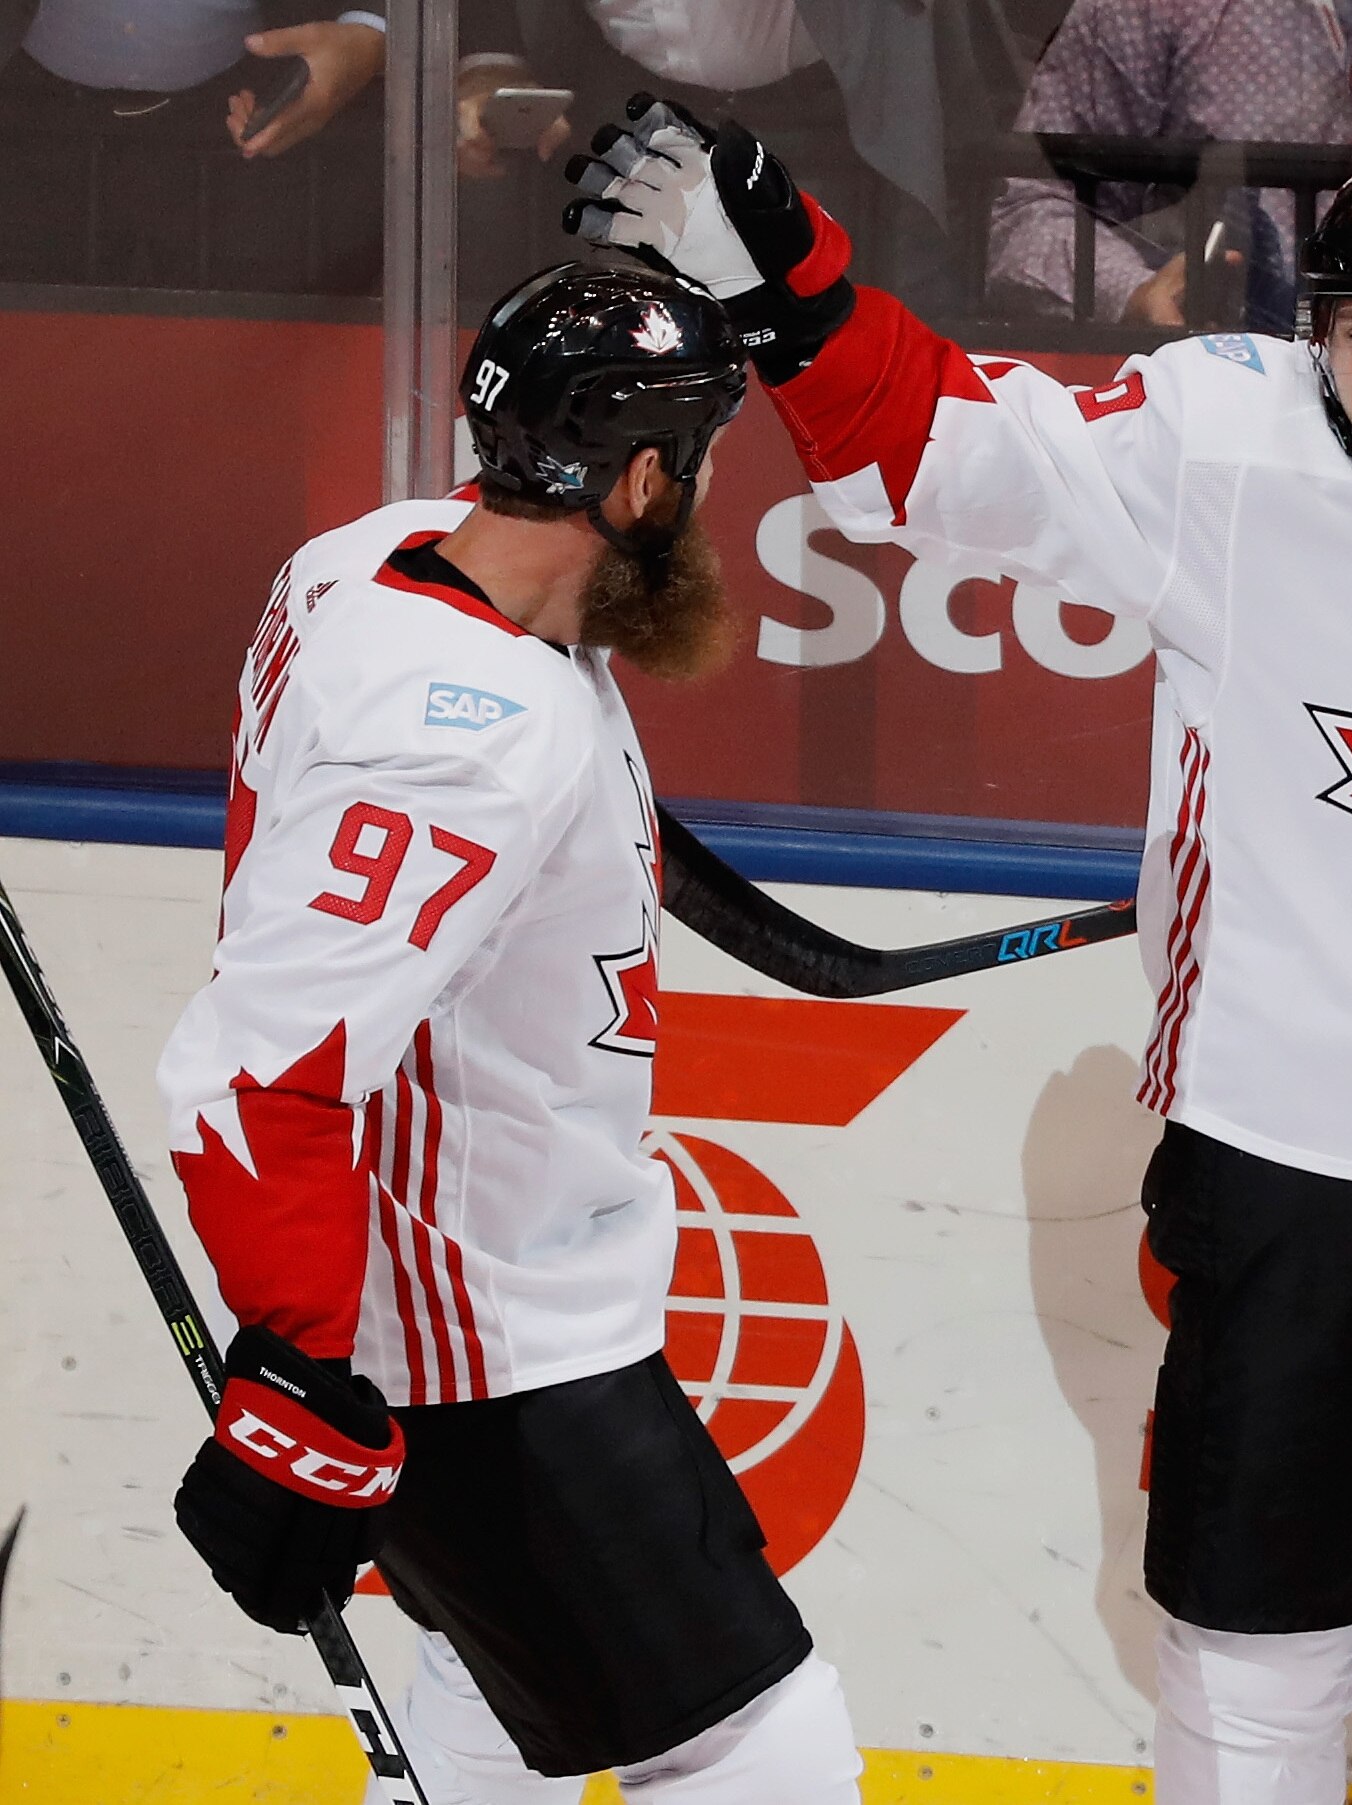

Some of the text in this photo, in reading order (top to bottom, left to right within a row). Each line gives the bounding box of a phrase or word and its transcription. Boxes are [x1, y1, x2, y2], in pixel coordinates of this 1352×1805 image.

[470, 359, 510, 412] 97
[428, 690, 503, 724] SAP
[307, 800, 498, 952] 97
[998, 919, 1088, 962] QRL
[259, 1366, 307, 1399] THORNTON
[228, 1408, 403, 1497] CCM
